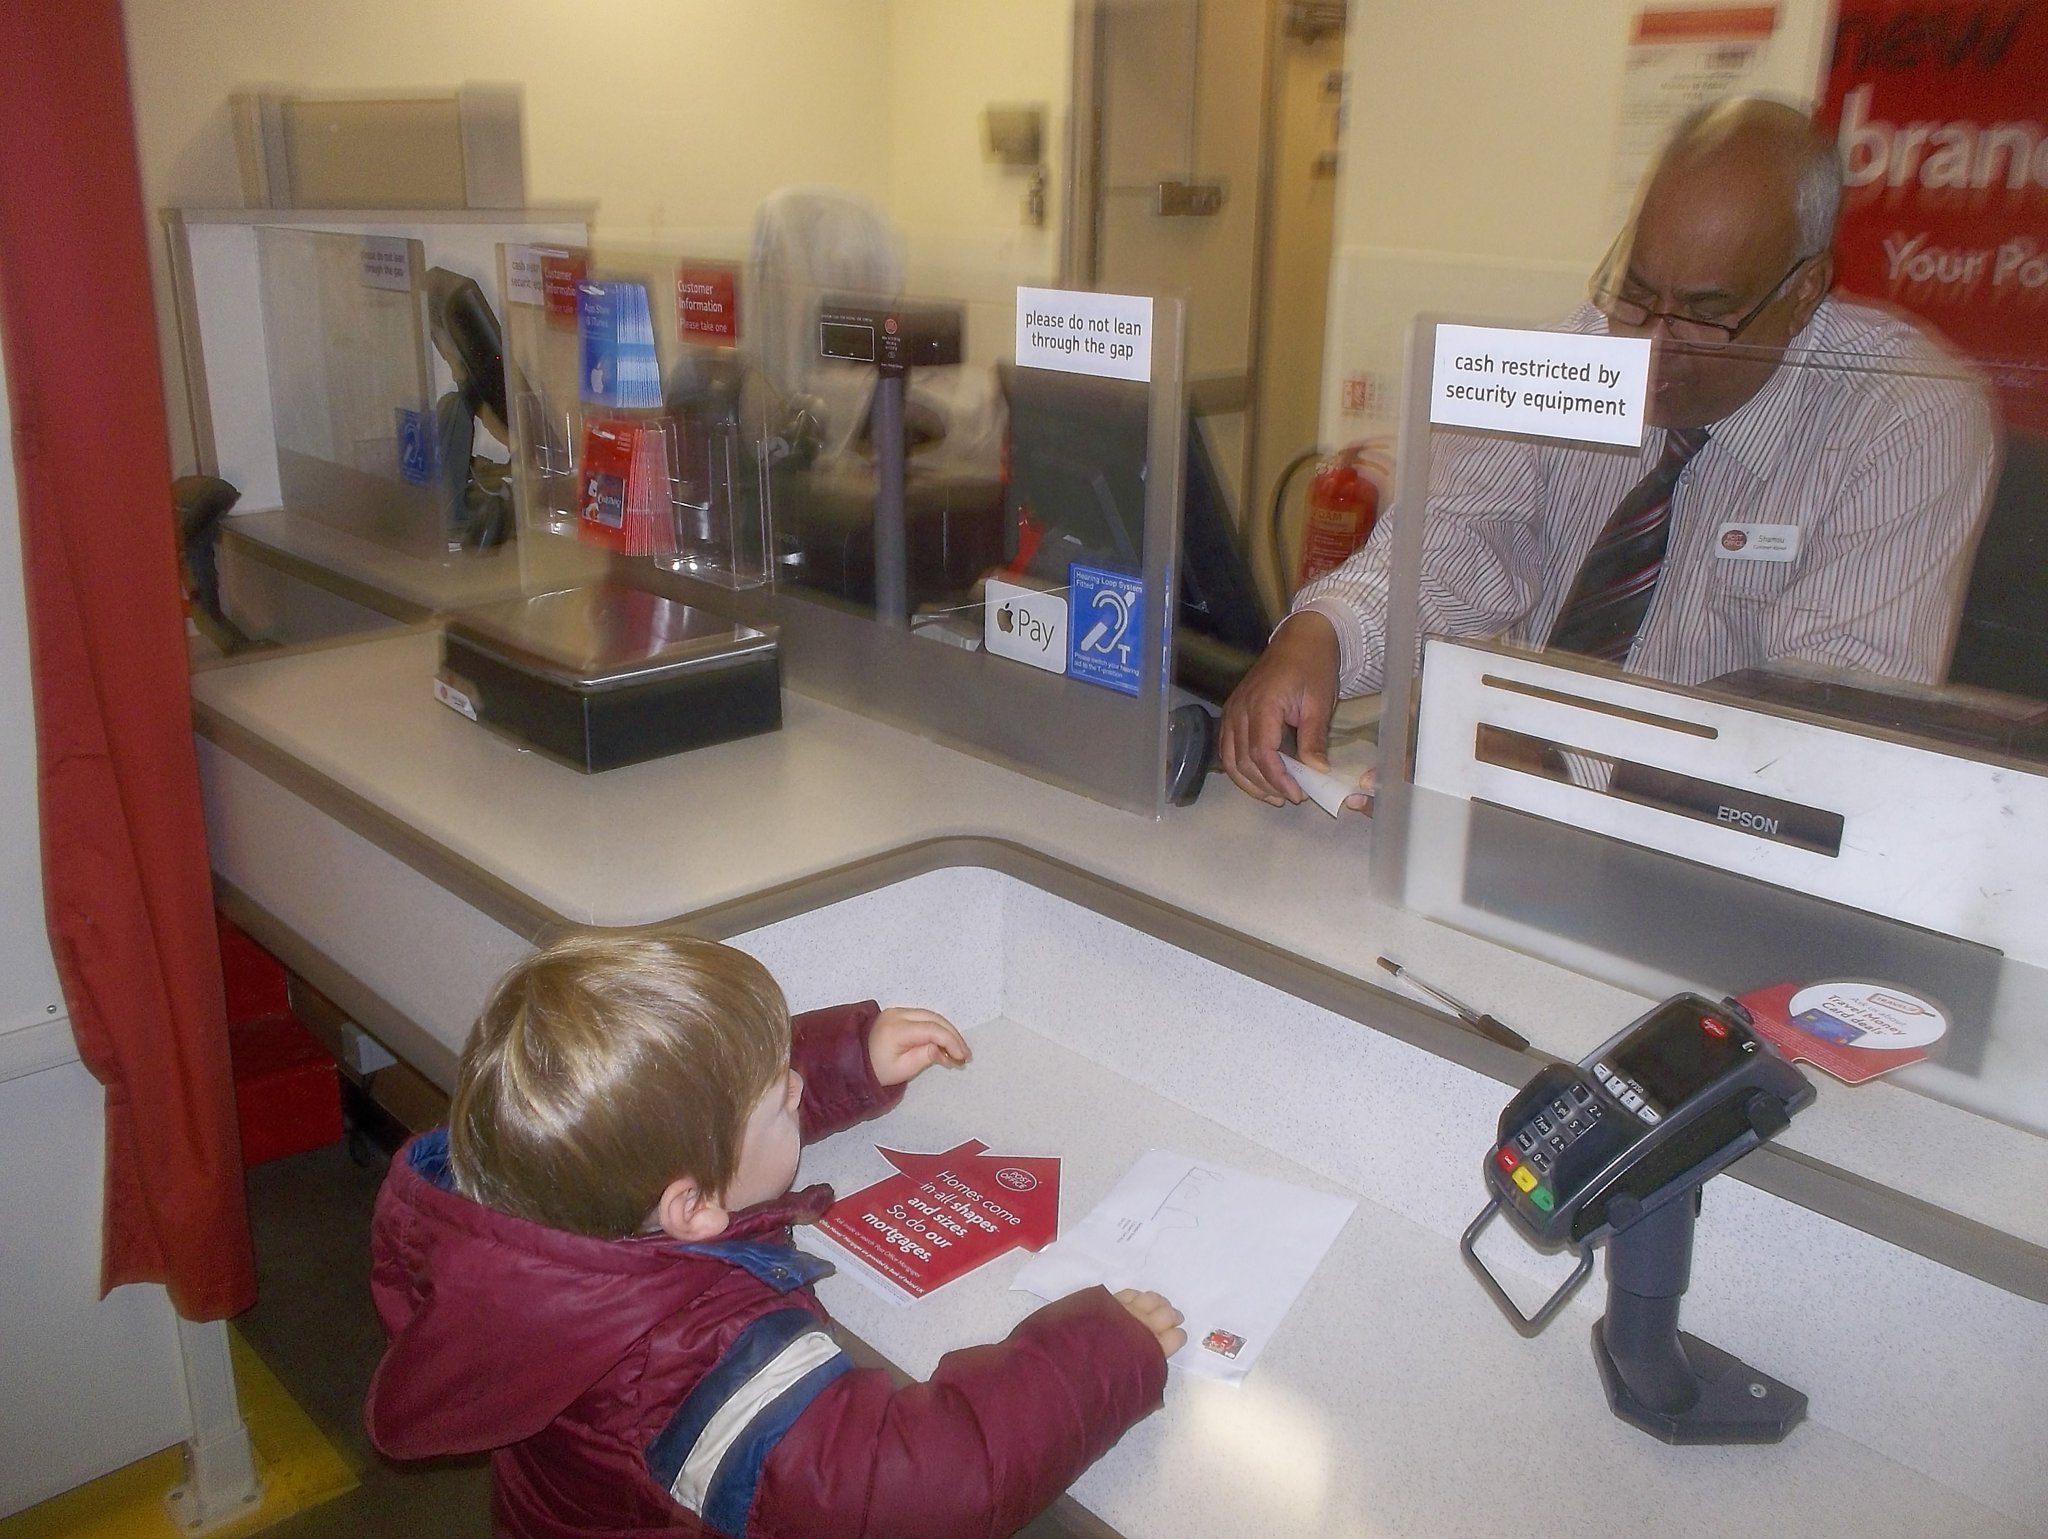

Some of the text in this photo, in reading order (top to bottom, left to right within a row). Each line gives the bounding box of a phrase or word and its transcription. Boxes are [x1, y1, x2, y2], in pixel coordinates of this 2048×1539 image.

[511, 261, 526, 271] cash
[1883, 233, 1986, 284] Your
[544, 266, 572, 280] Customer
[678, 280, 714, 294] Customer
[679, 297, 723, 312] Information
[680, 318, 728, 333] Please take one
[1025, 310, 1141, 336] please do not lean
[1032, 332, 1134, 360] through the gap
[1455, 354, 1621, 389] cash restricted by
[1446, 384, 1627, 416] security equipment
[1076, 571, 1142, 593] Hearing Loop System
[1076, 580, 1094, 590] Fitted
[1018, 608, 1055, 652] Pay
[1118, 643, 1130, 664] T
[1717, 805, 1779, 835] EPSON
[1822, 1002, 1852, 1019] Card
[1828, 994, 1907, 1036] Travel Money
[1572, 1085, 1579, 1093] 1
[1553, 1100, 1561, 1108] 4
[1589, 1105, 1598, 1113] 2
[1570, 1120, 1579, 1128] 5
[1551, 1136, 1560, 1145] 8
[1533, 1153, 1542, 1162] 0
[1000, 1172, 1028, 1190] OFFICE
[1010, 1171, 1032, 1184] POST
[936, 1170, 1021, 1225] Homes come
[920, 1182, 998, 1233] in all shapes
[886, 1204, 952, 1248] So do our
[907, 1197, 968, 1238] and sizes.
[862, 1213, 932, 1263] mortgages.
[843, 1236, 863, 1252] Mortgages
[866, 1252, 886, 1268] provided
[888, 1267, 900, 1277] Bank
[916, 1286, 924, 1294] UK
[884, 1250, 899, 1263] Office
